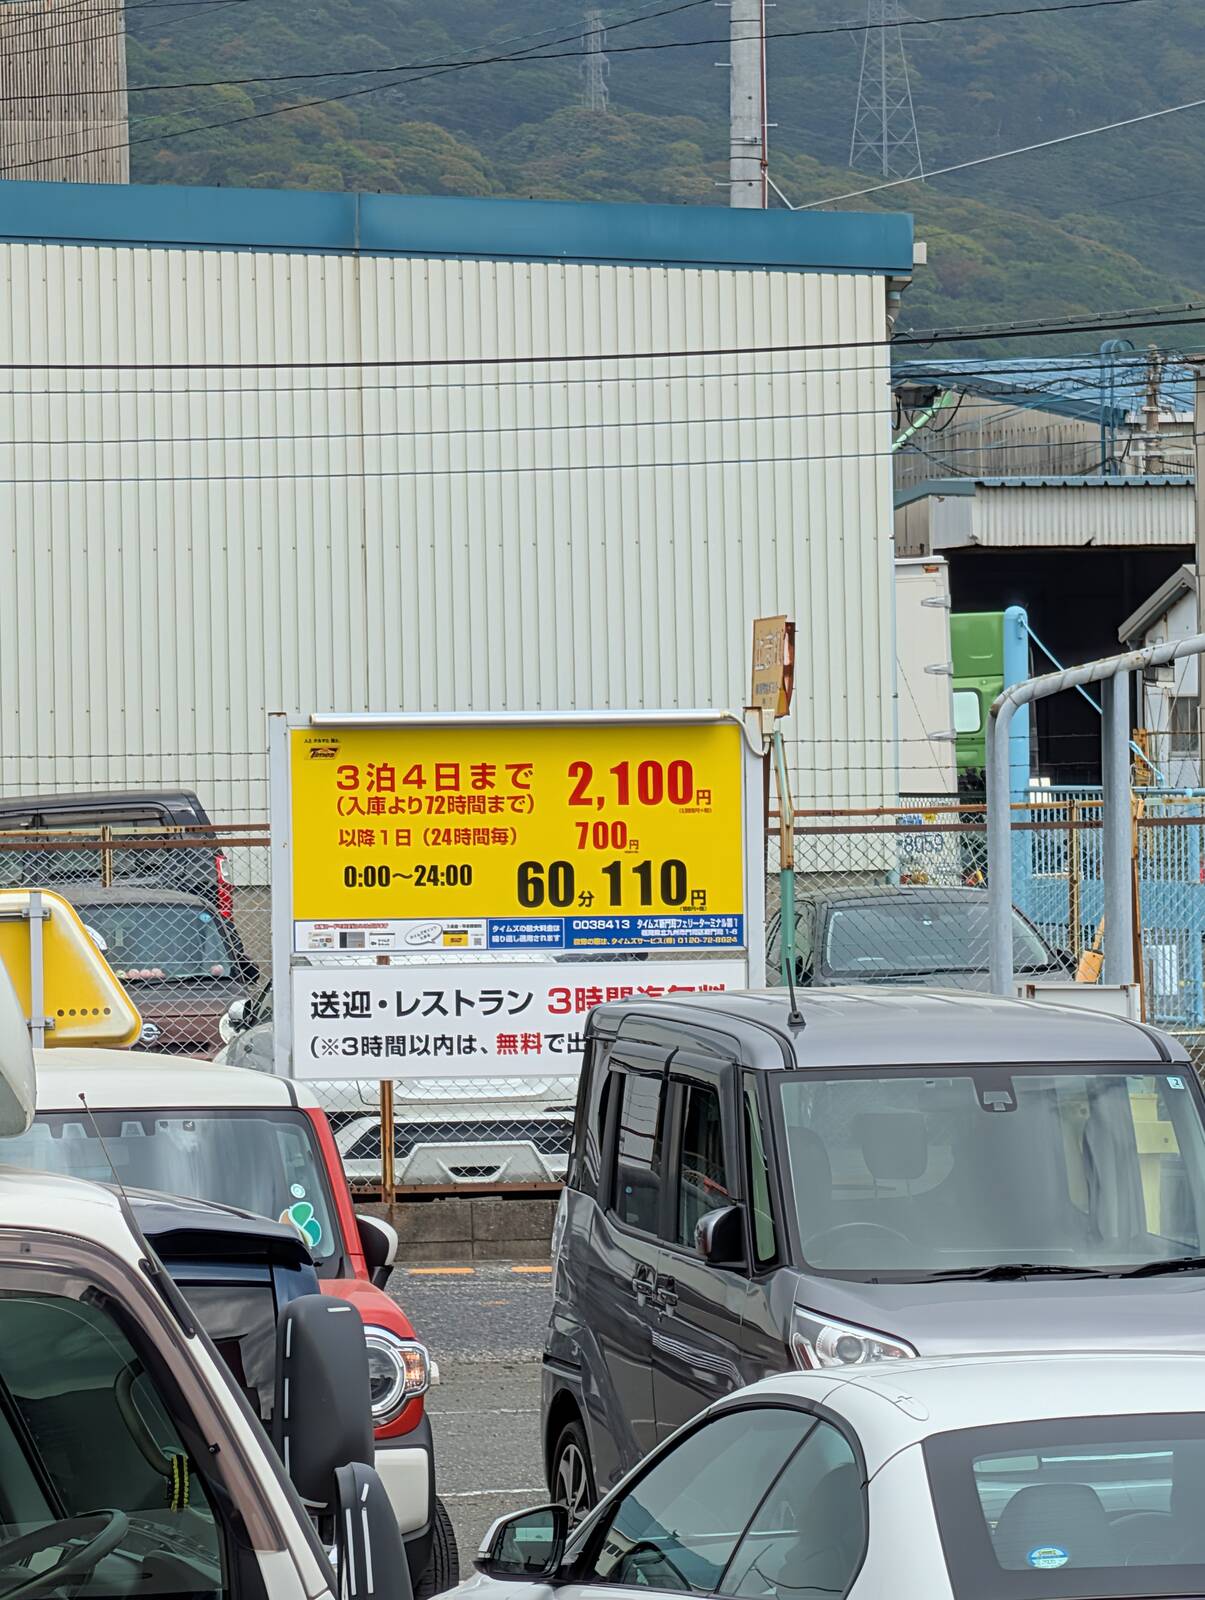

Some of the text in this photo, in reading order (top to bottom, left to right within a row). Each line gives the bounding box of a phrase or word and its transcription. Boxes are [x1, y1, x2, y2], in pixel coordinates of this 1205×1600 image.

[336, 760, 712, 811] 3泊4日まで 2,100円
[336, 794, 535, 816] (入庫より72時間まで)
[575, 820, 639, 850] 700円
[572, 919, 631, 930] 0038413
[310, 984, 725, 1020] 送迎・レストラン 3時間
